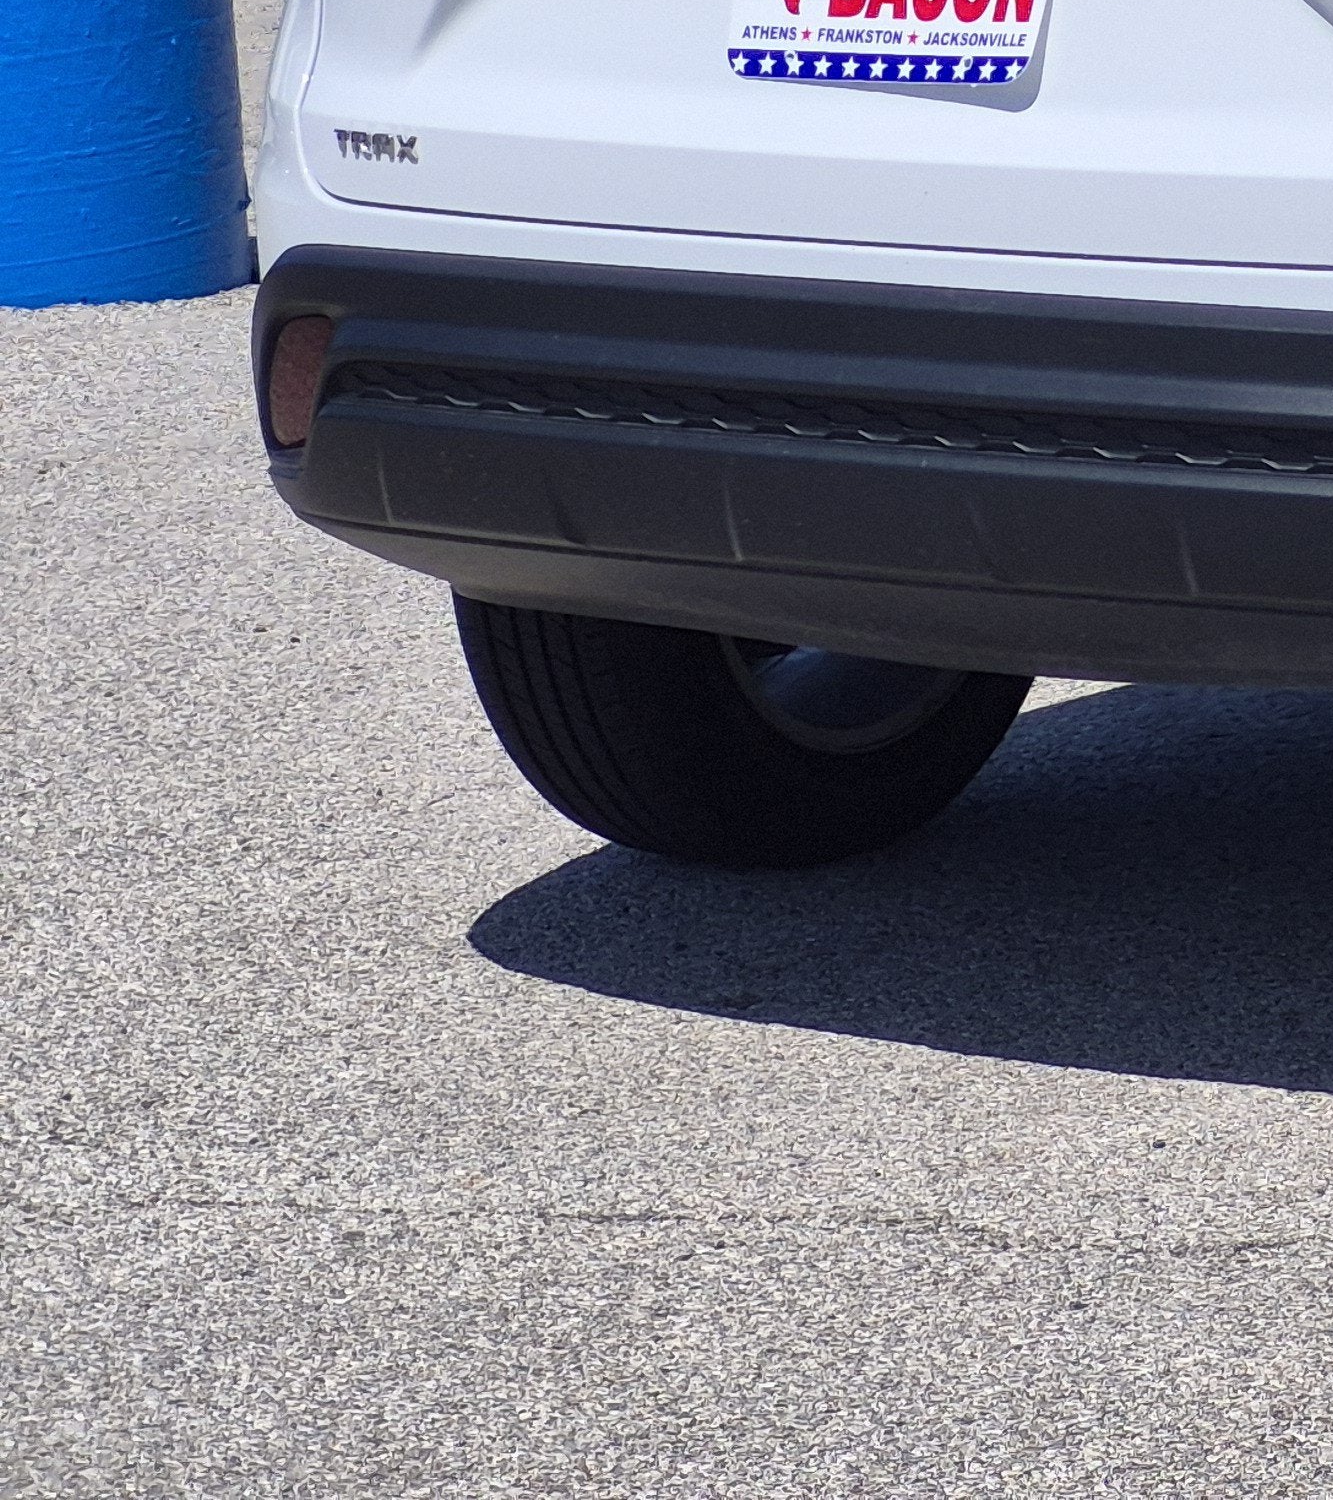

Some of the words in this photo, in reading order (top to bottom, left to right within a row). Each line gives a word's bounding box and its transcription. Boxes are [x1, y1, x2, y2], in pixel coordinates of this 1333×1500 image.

[742, 25, 797, 41] ATHENS
[817, 28, 903, 44] FRANKSTON
[923, 31, 1028, 48] JACKSONVILLE
[333, 128, 419, 165] TRAX
